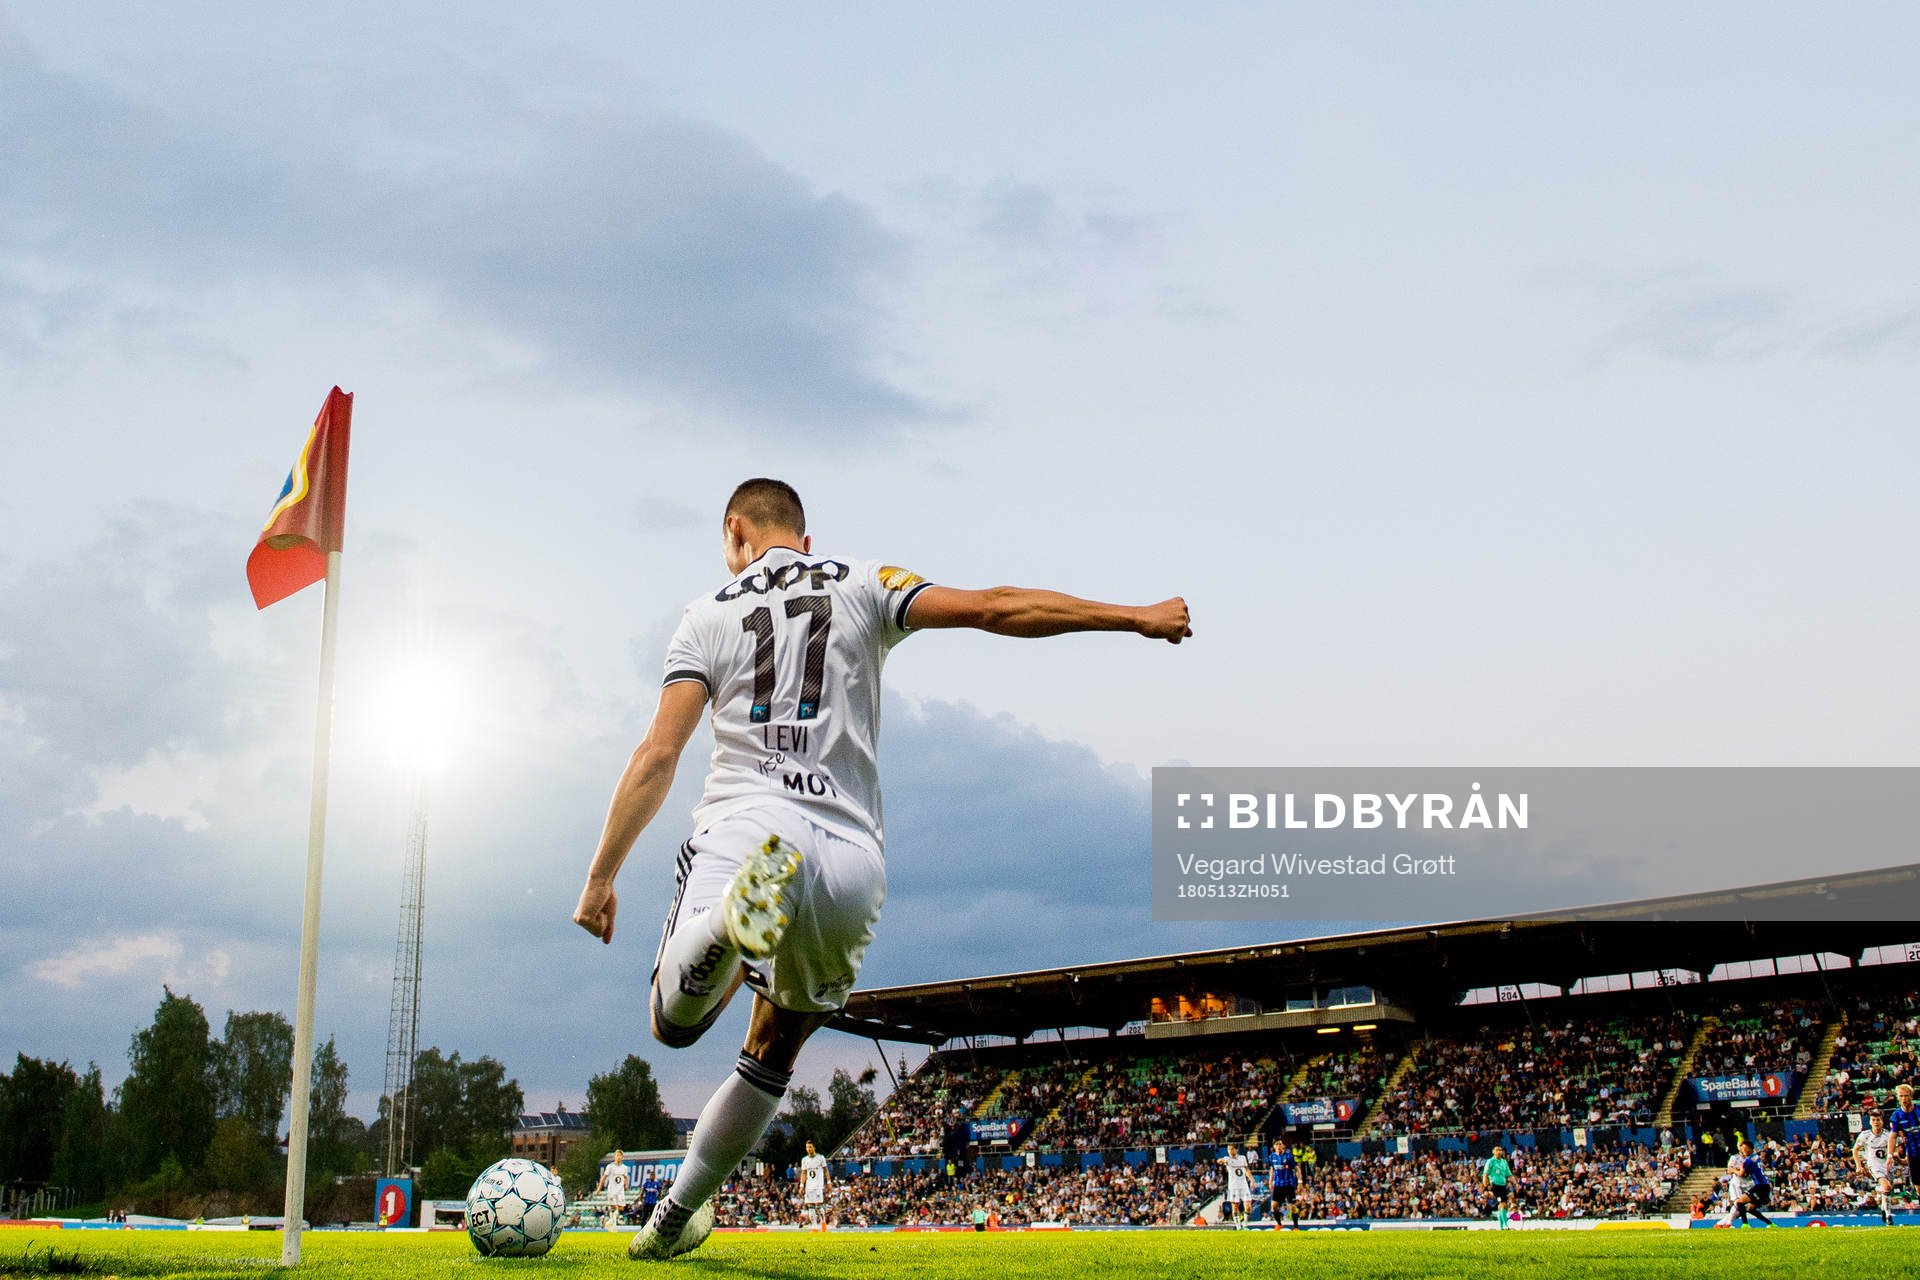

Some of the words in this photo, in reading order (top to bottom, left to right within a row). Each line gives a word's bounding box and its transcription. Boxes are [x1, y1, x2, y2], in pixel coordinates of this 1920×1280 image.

[742, 595, 832, 723] 17
[764, 724, 808, 753] LEVI
[1657, 975, 1676, 985] 205
[1501, 991, 1518, 1001] 204
[1128, 1026, 1142, 1034] 202
[1701, 1077, 1760, 1093] SpareBank
[1767, 1078, 1776, 1092] 1
[1289, 1103, 1334, 1117] SpareBa
[1339, 1104, 1347, 1117] 1
[385, 1191, 396, 1217] 1
